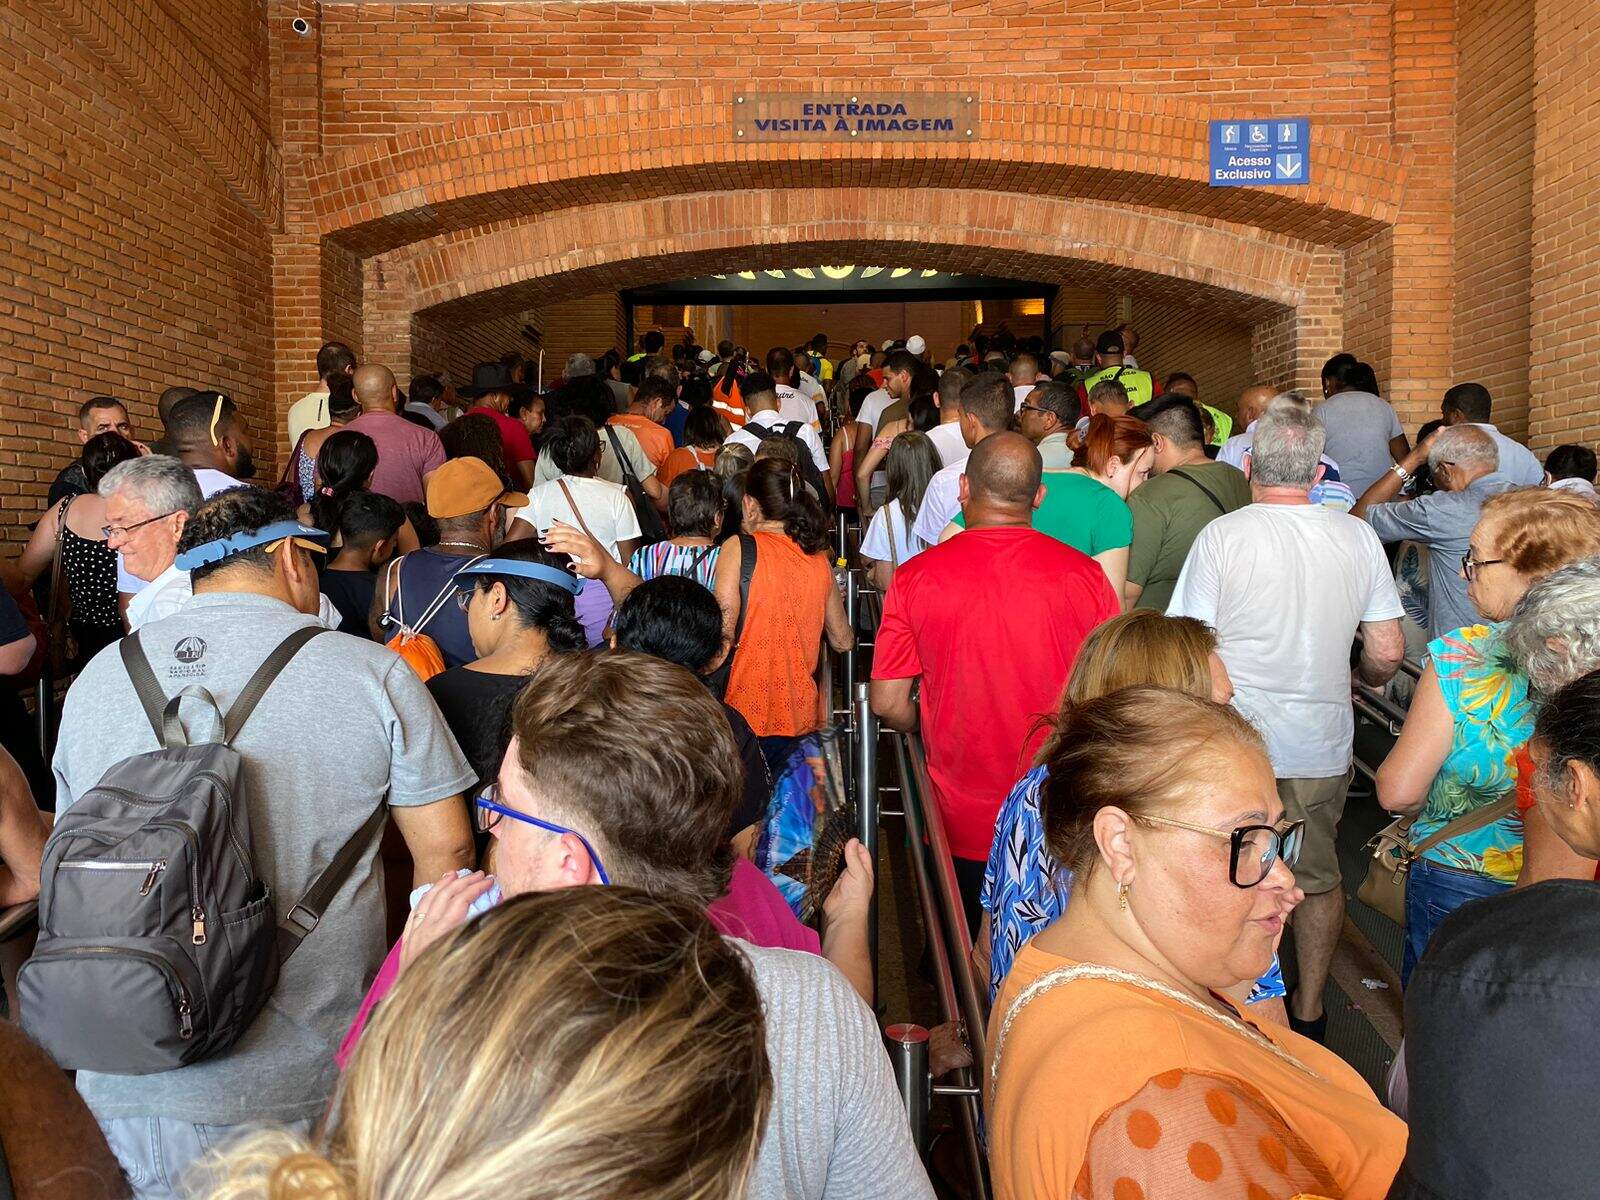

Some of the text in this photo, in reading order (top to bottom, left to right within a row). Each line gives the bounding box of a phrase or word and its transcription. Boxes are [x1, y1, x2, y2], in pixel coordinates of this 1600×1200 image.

[803, 103, 907, 116] ENTRADA
[754, 116, 954, 131] VISITA À IMAGEM
[1228, 156, 1271, 166] Acesso
[1215, 168, 1271, 179] Exclusivo
